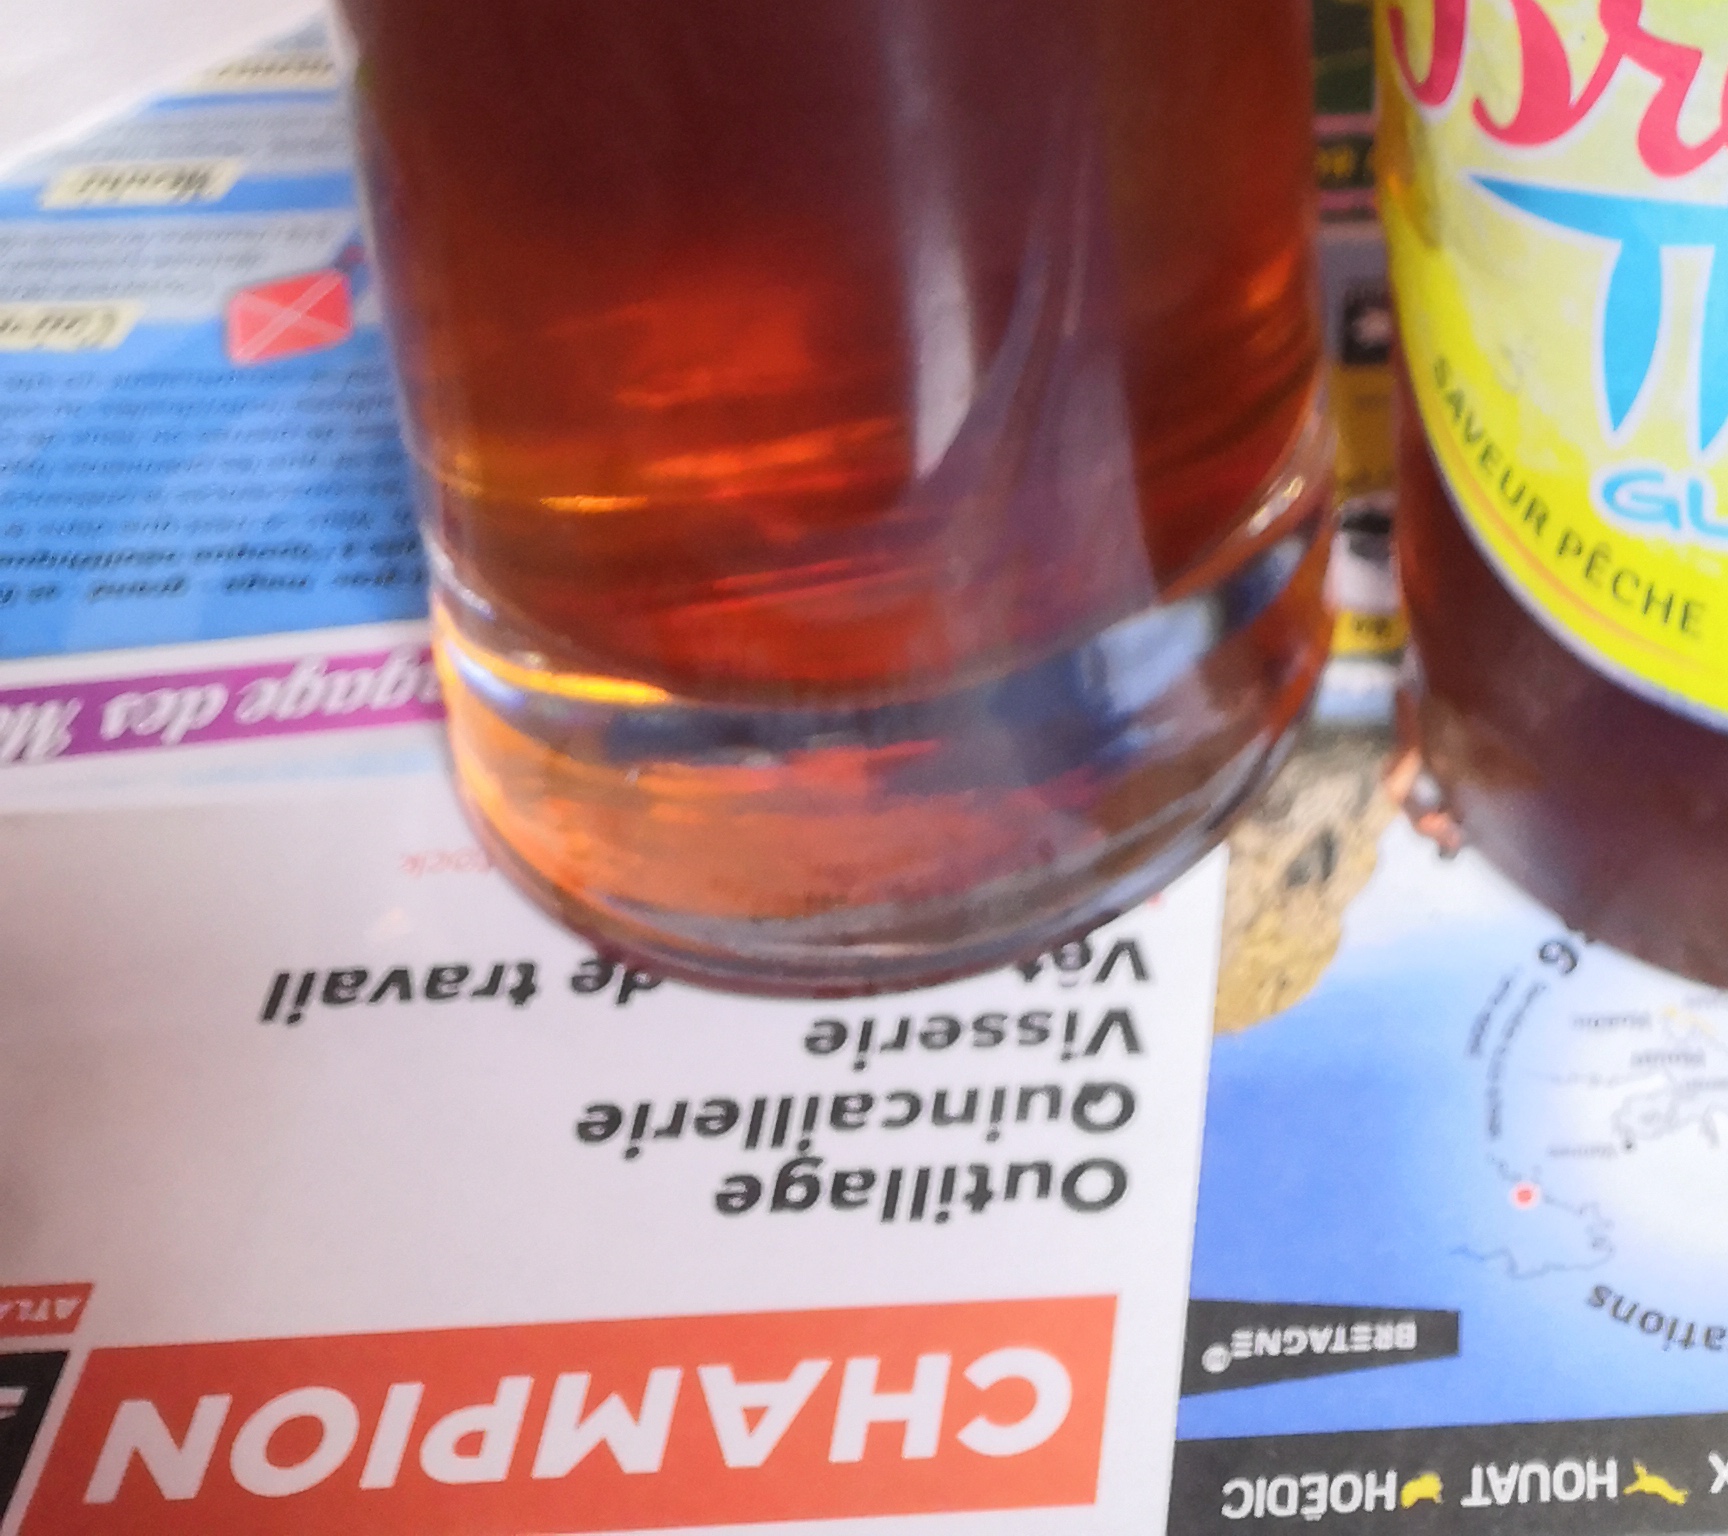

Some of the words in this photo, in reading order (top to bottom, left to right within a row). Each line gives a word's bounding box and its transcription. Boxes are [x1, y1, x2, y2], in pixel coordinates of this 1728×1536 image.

[1434, 357, 1551, 536] SAVEUR
[1558, 529, 1706, 640] PÊCHE
[99, 683, 229, 746] des
[260, 960, 539, 1025] travail
[570, 958, 659, 1005] de
[1015, 938, 1148, 990] Vêt
[802, 1006, 1143, 1071] Visserie
[576, 1080, 1136, 1160] Quincaillerie
[713, 1155, 1129, 1224] Outillage
[1232, 1319, 1416, 1354] BRETAGNE
[83, 1346, 1074, 1504] CHAMPION
[1460, 1458, 1619, 1509] HOUAT
